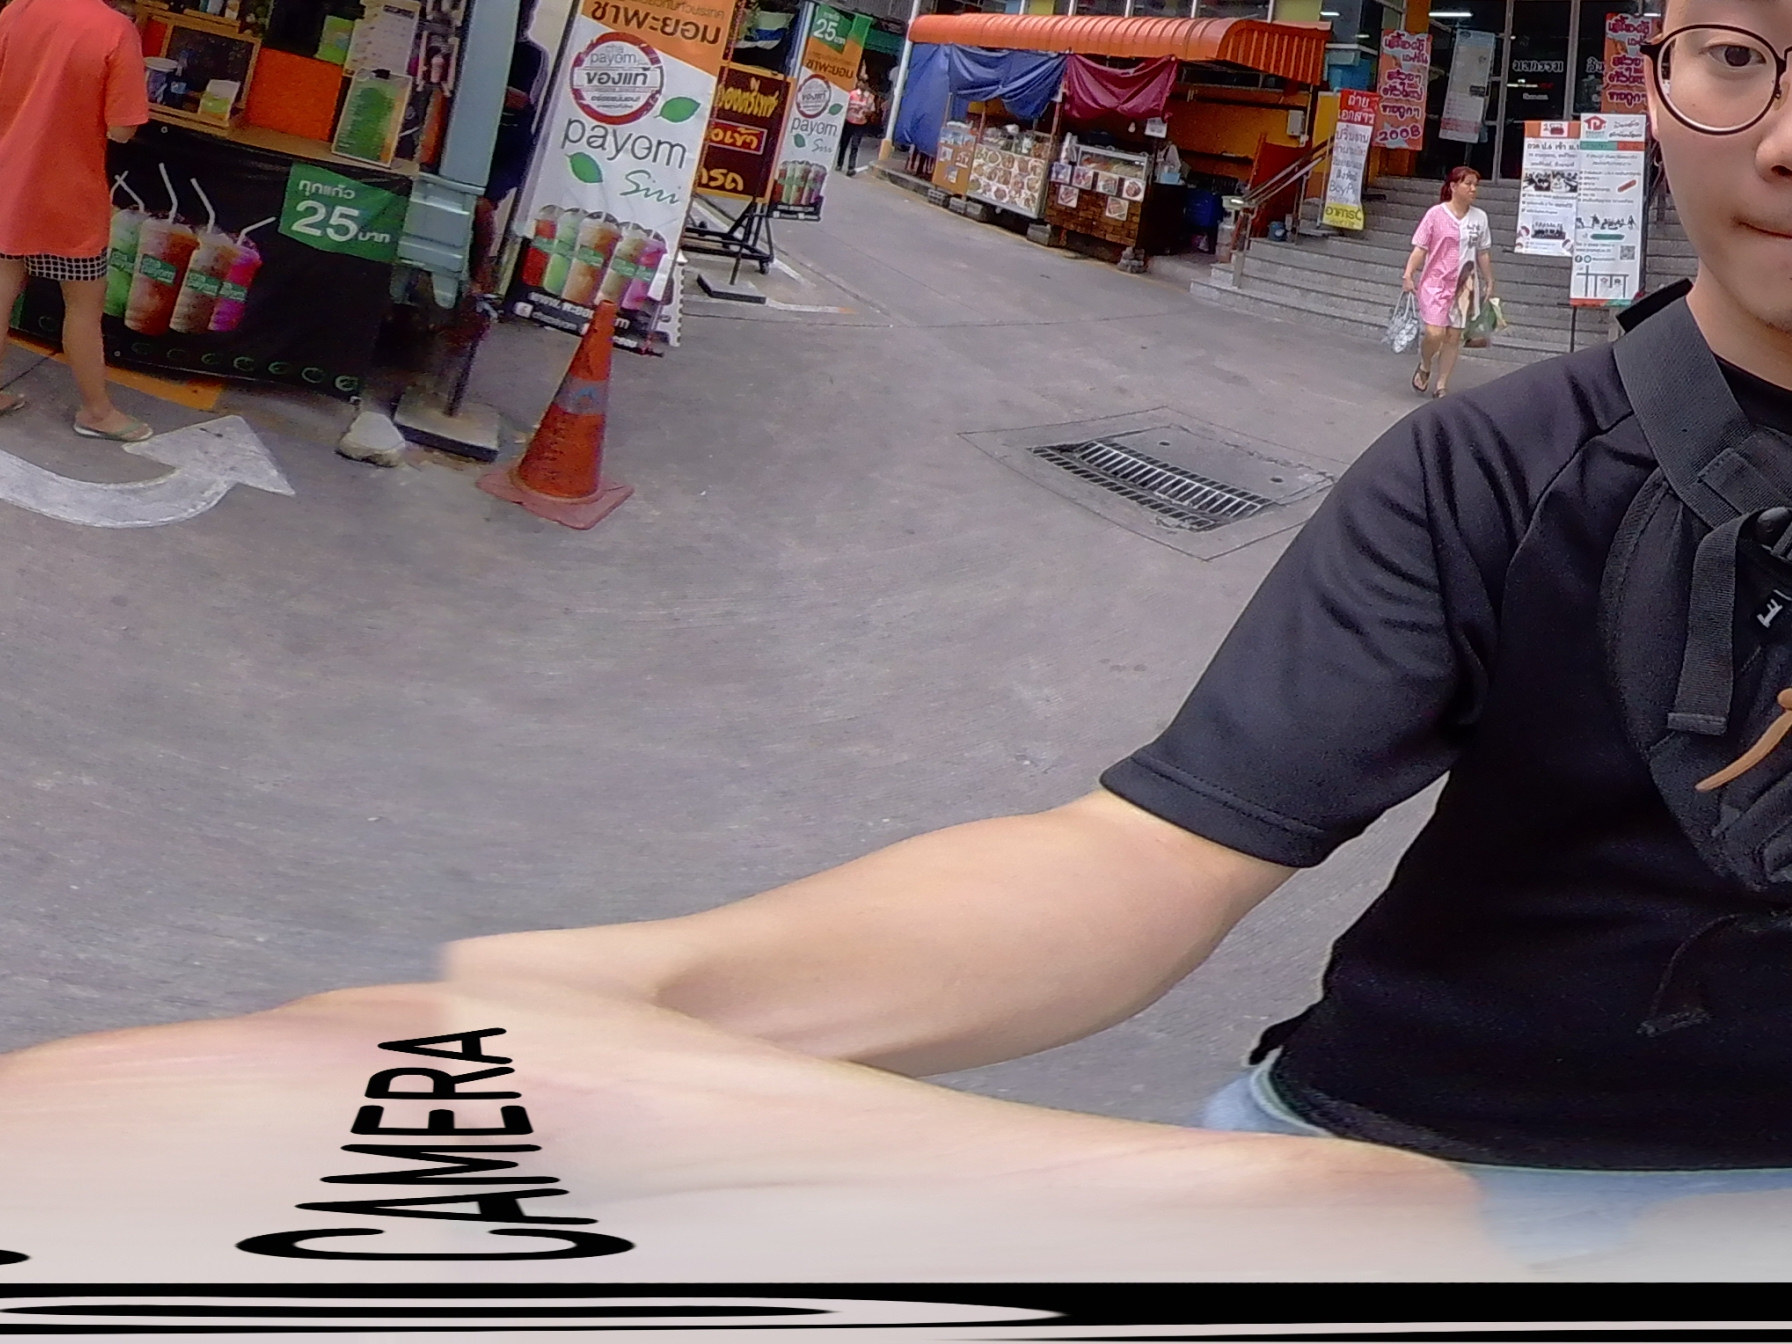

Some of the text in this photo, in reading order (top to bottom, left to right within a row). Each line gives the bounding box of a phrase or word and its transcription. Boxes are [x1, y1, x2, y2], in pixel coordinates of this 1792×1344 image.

[591, 1, 722, 45] ชาพะยอม
[813, 18, 838, 42] 25
[589, 52, 637, 66] payom
[805, 58, 856, 79] ชาพะยอม
[585, 67, 651, 85] ของแท้
[790, 117, 838, 137] payom
[561, 118, 687, 169] payom
[298, 179, 356, 200] ทุกแก้ว
[619, 169, 683, 205] Siri
[290, 199, 392, 243] 25 บาท
